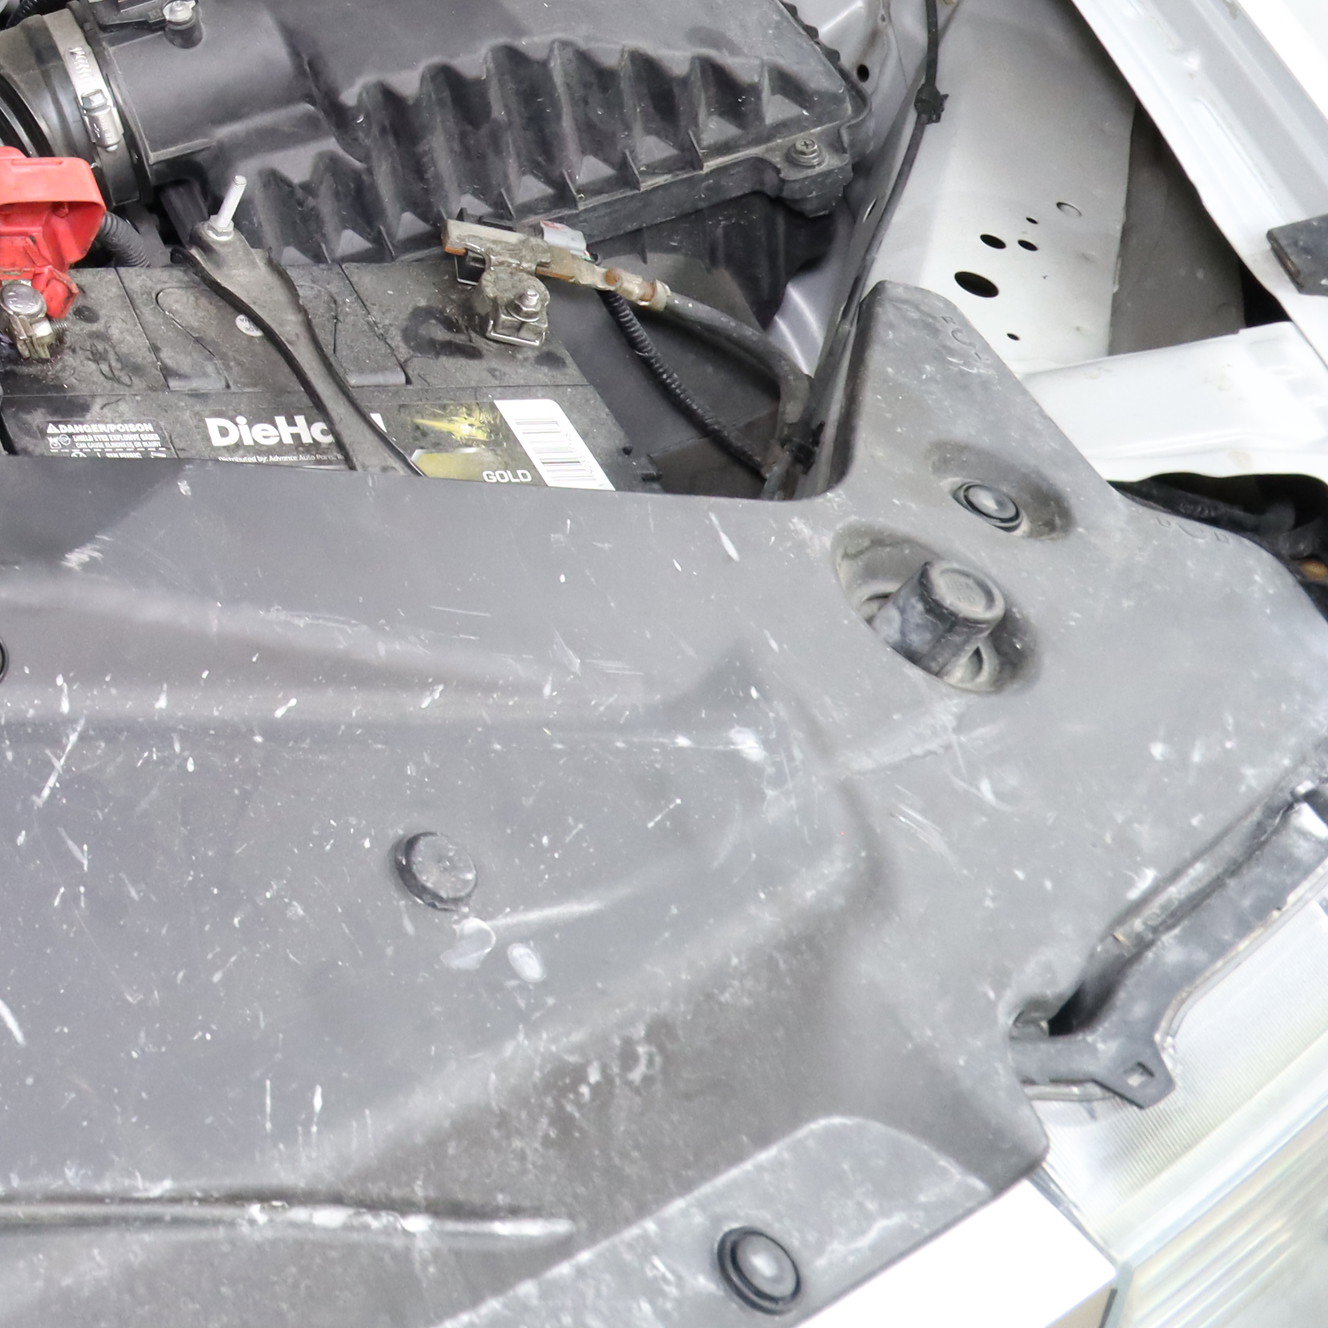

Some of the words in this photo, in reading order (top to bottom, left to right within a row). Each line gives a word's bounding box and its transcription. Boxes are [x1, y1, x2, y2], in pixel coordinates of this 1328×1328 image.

[57, 422, 155, 433] DANGER/POISON
[205, 413, 396, 447] DieHa
[482, 469, 532, 484] GOLD
